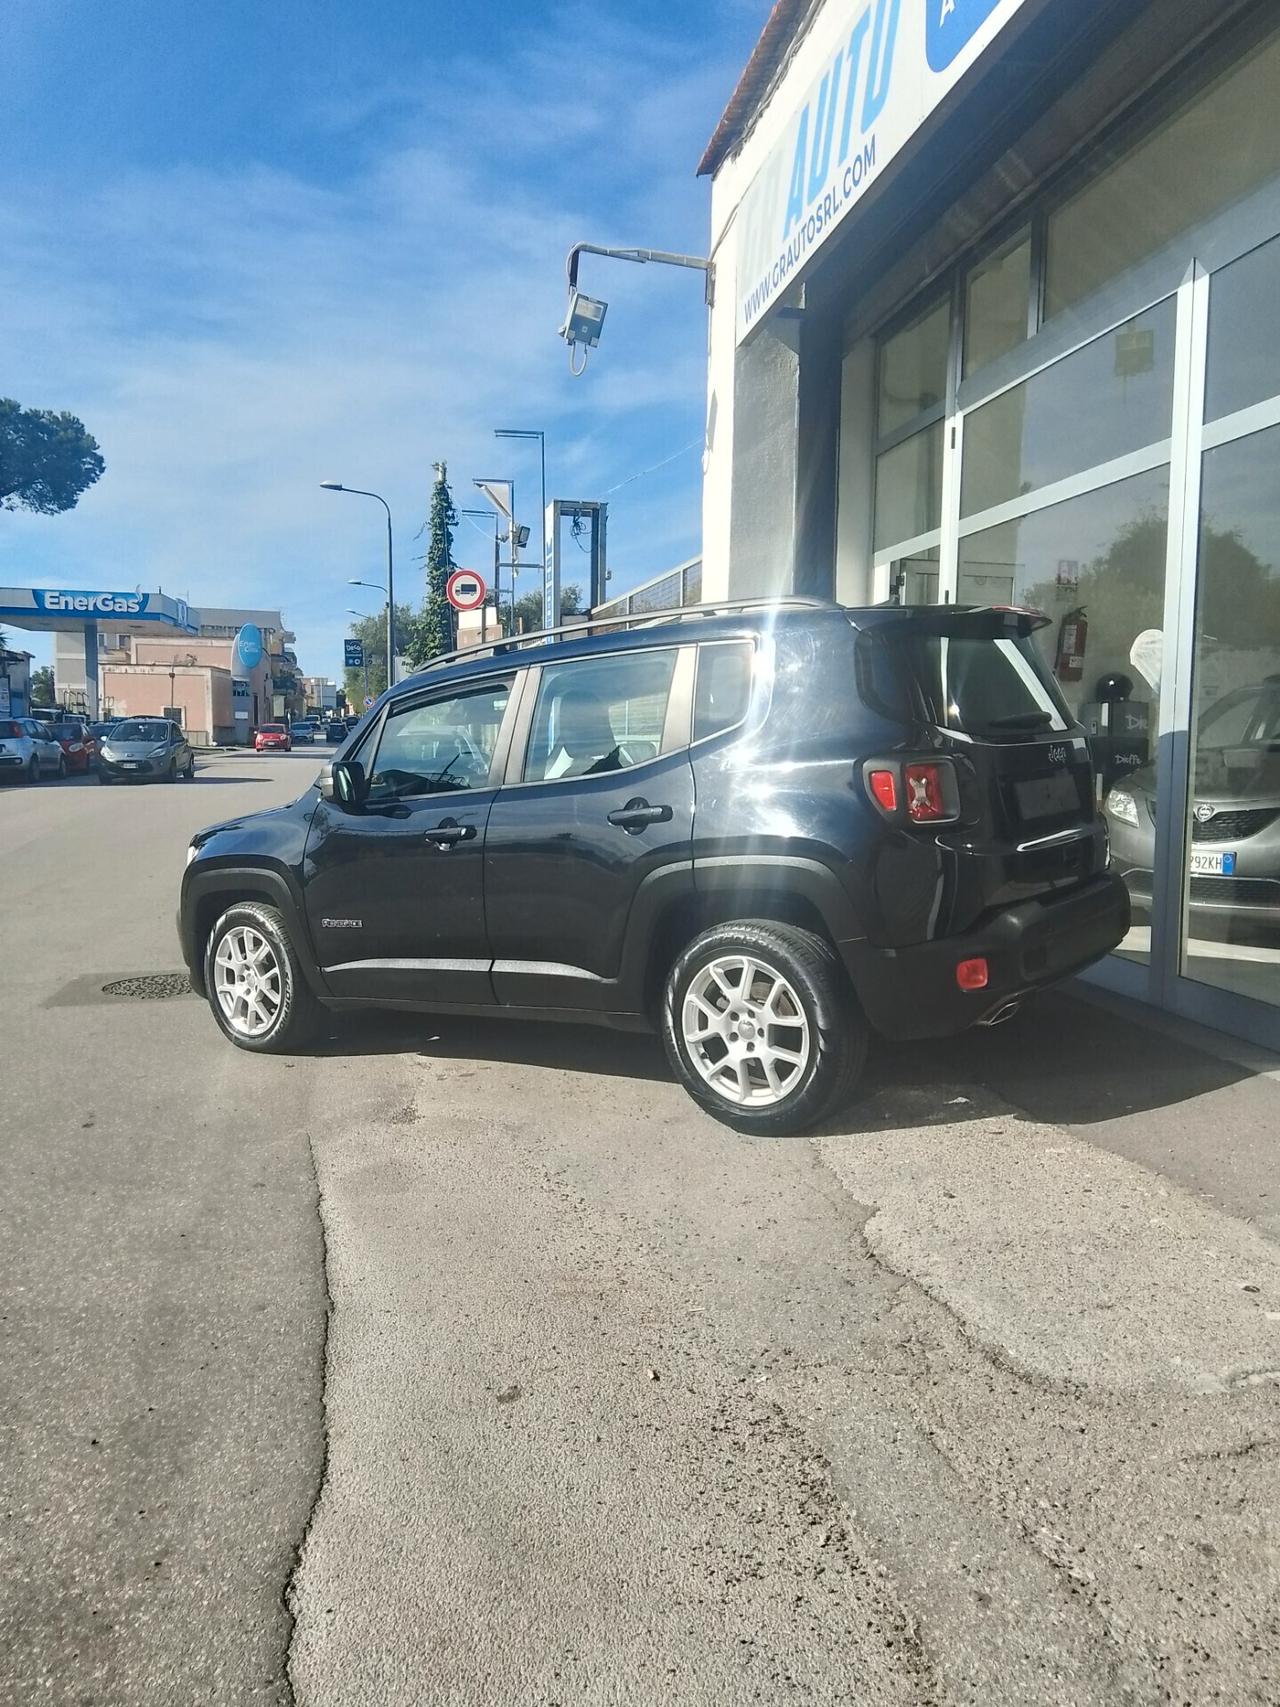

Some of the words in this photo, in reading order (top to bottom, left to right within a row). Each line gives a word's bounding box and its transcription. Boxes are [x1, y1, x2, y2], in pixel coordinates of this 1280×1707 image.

[783, 0, 899, 242] AUTO
[744, 133, 876, 324] WWW.GRAUTOSRL.COM
[44, 591, 141, 613] EnerGas
